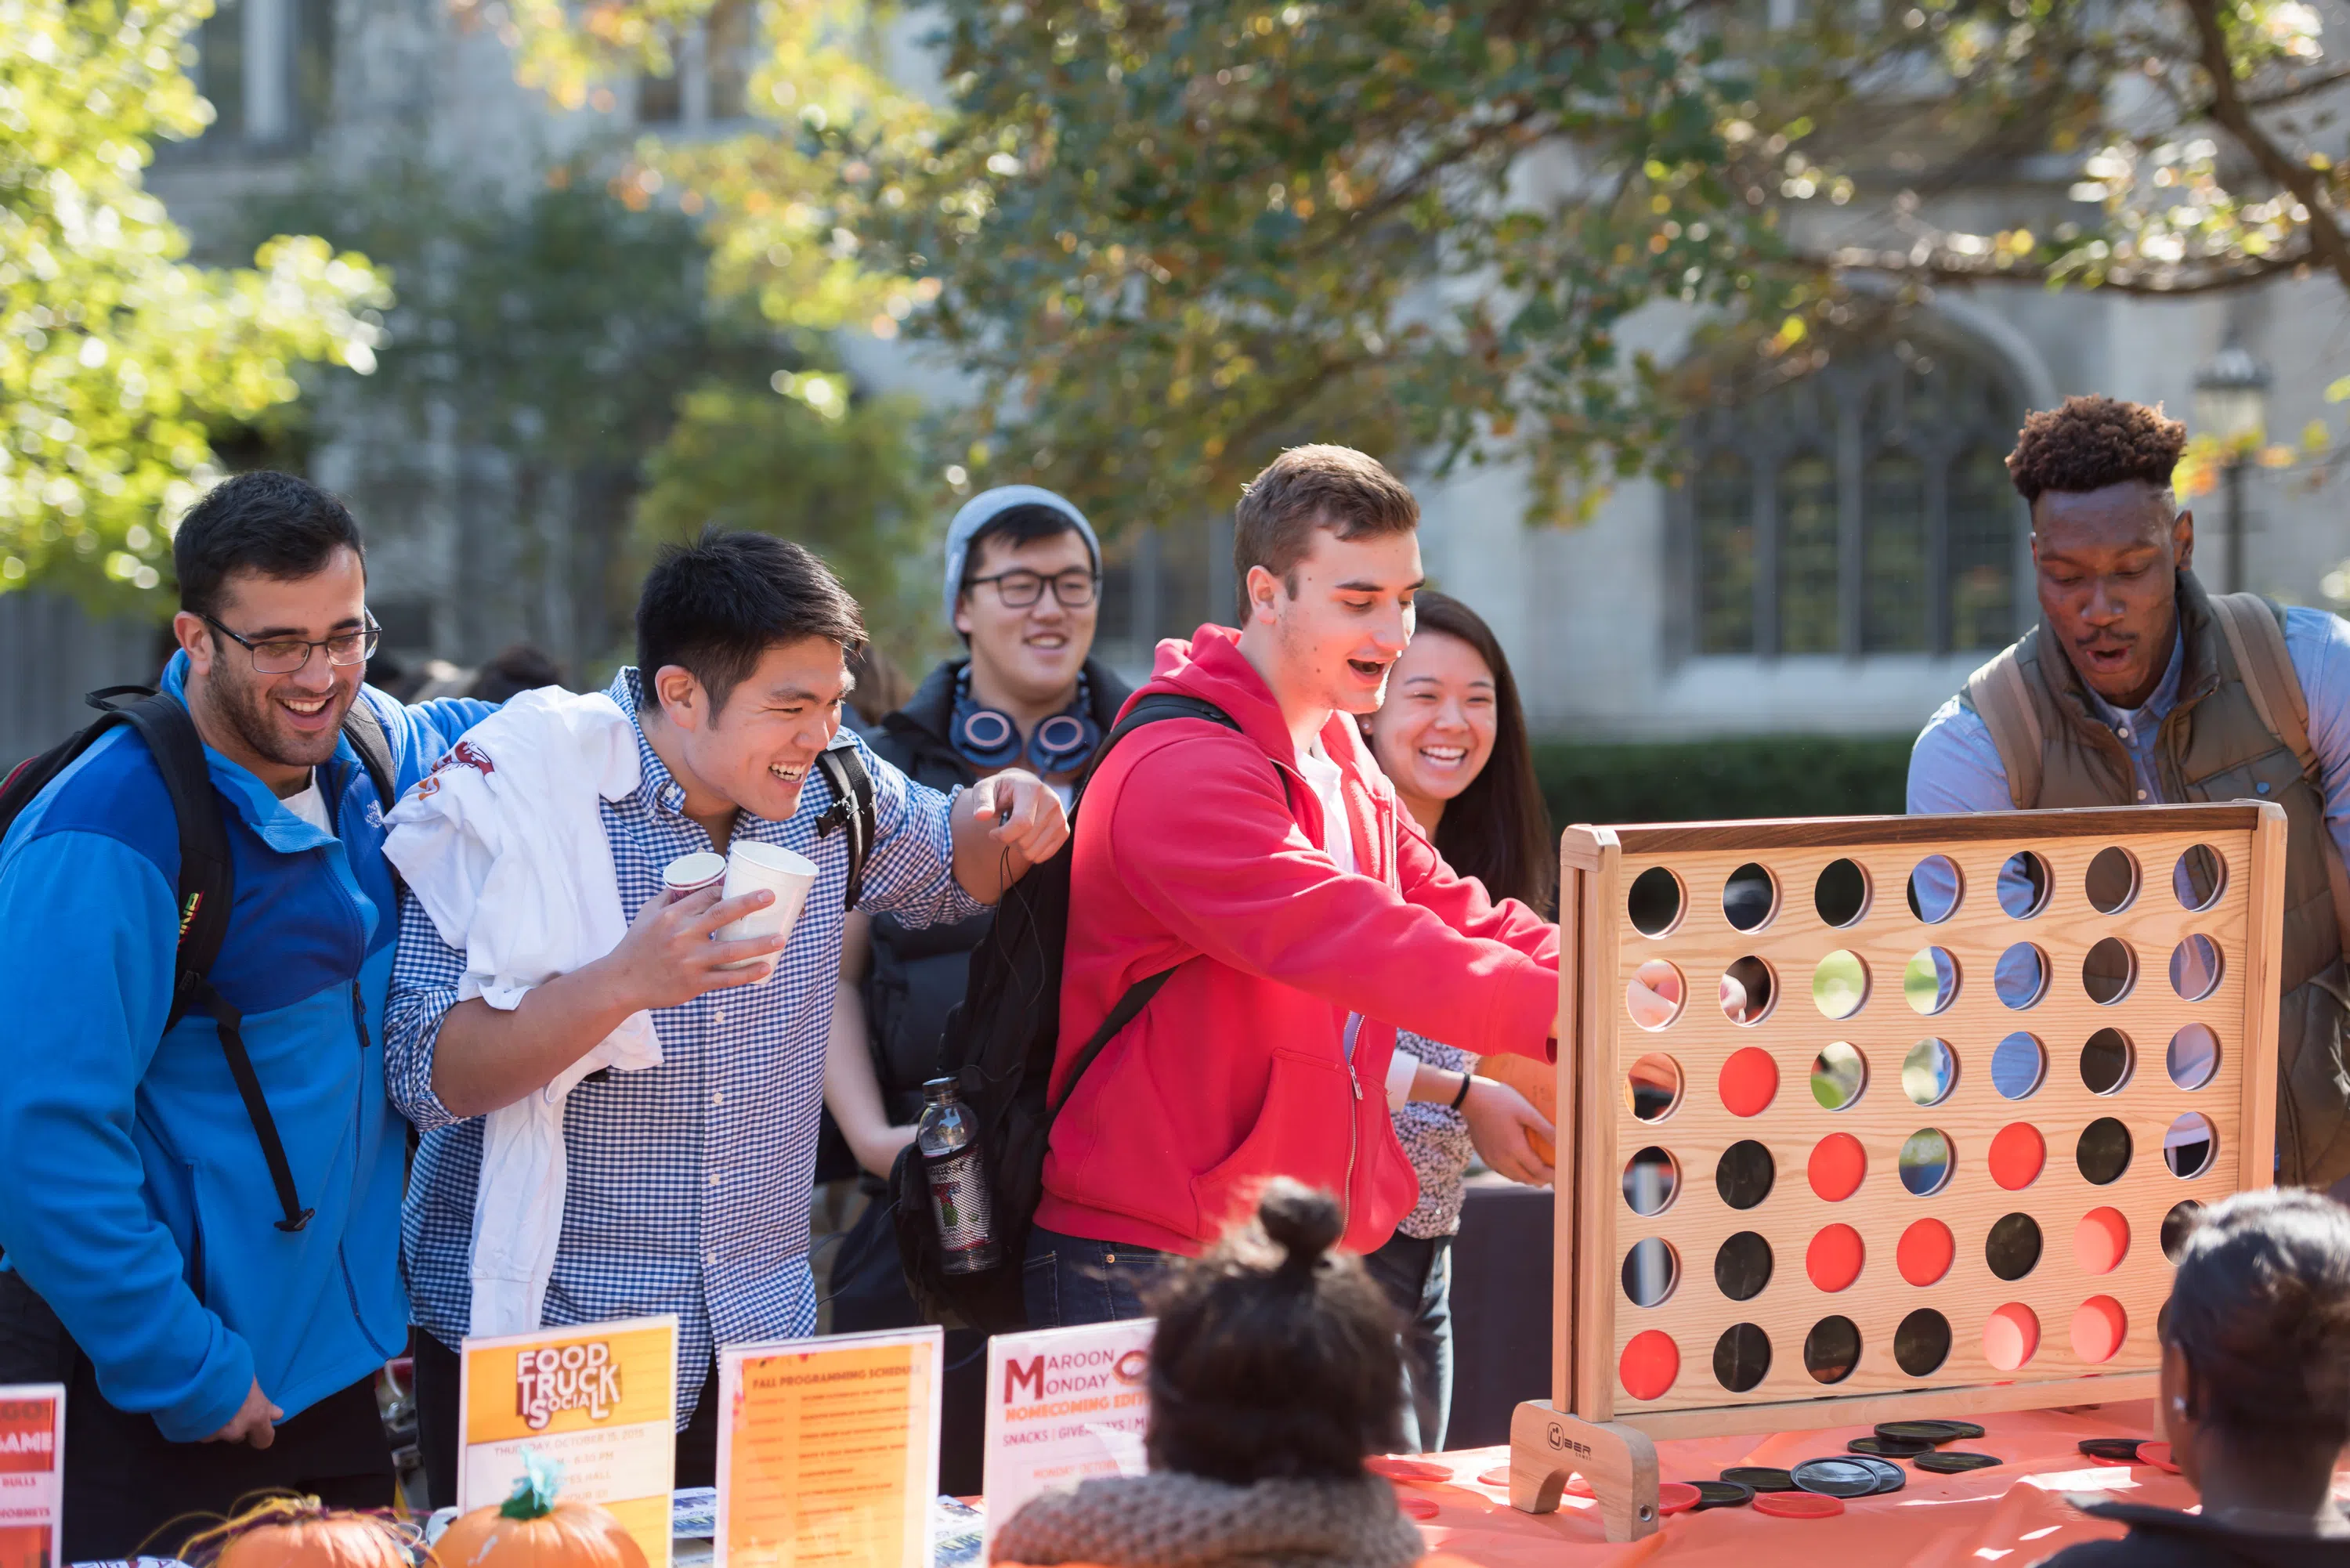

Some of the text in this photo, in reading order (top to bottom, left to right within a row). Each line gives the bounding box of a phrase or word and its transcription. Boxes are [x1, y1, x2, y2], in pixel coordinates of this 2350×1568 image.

[517, 1342, 609, 1375] FOOD
[517, 1364, 620, 1415] TRUCK
[752, 1378, 777, 1389] FALL
[779, 1371, 866, 1387] PROGRAMMING
[528, 1390, 609, 1429] SOCIAL
[1005, 1396, 1110, 1423] HOMECOMING
[0, 1431, 52, 1454] AME
[1003, 1429, 1048, 1447] SNACKS
